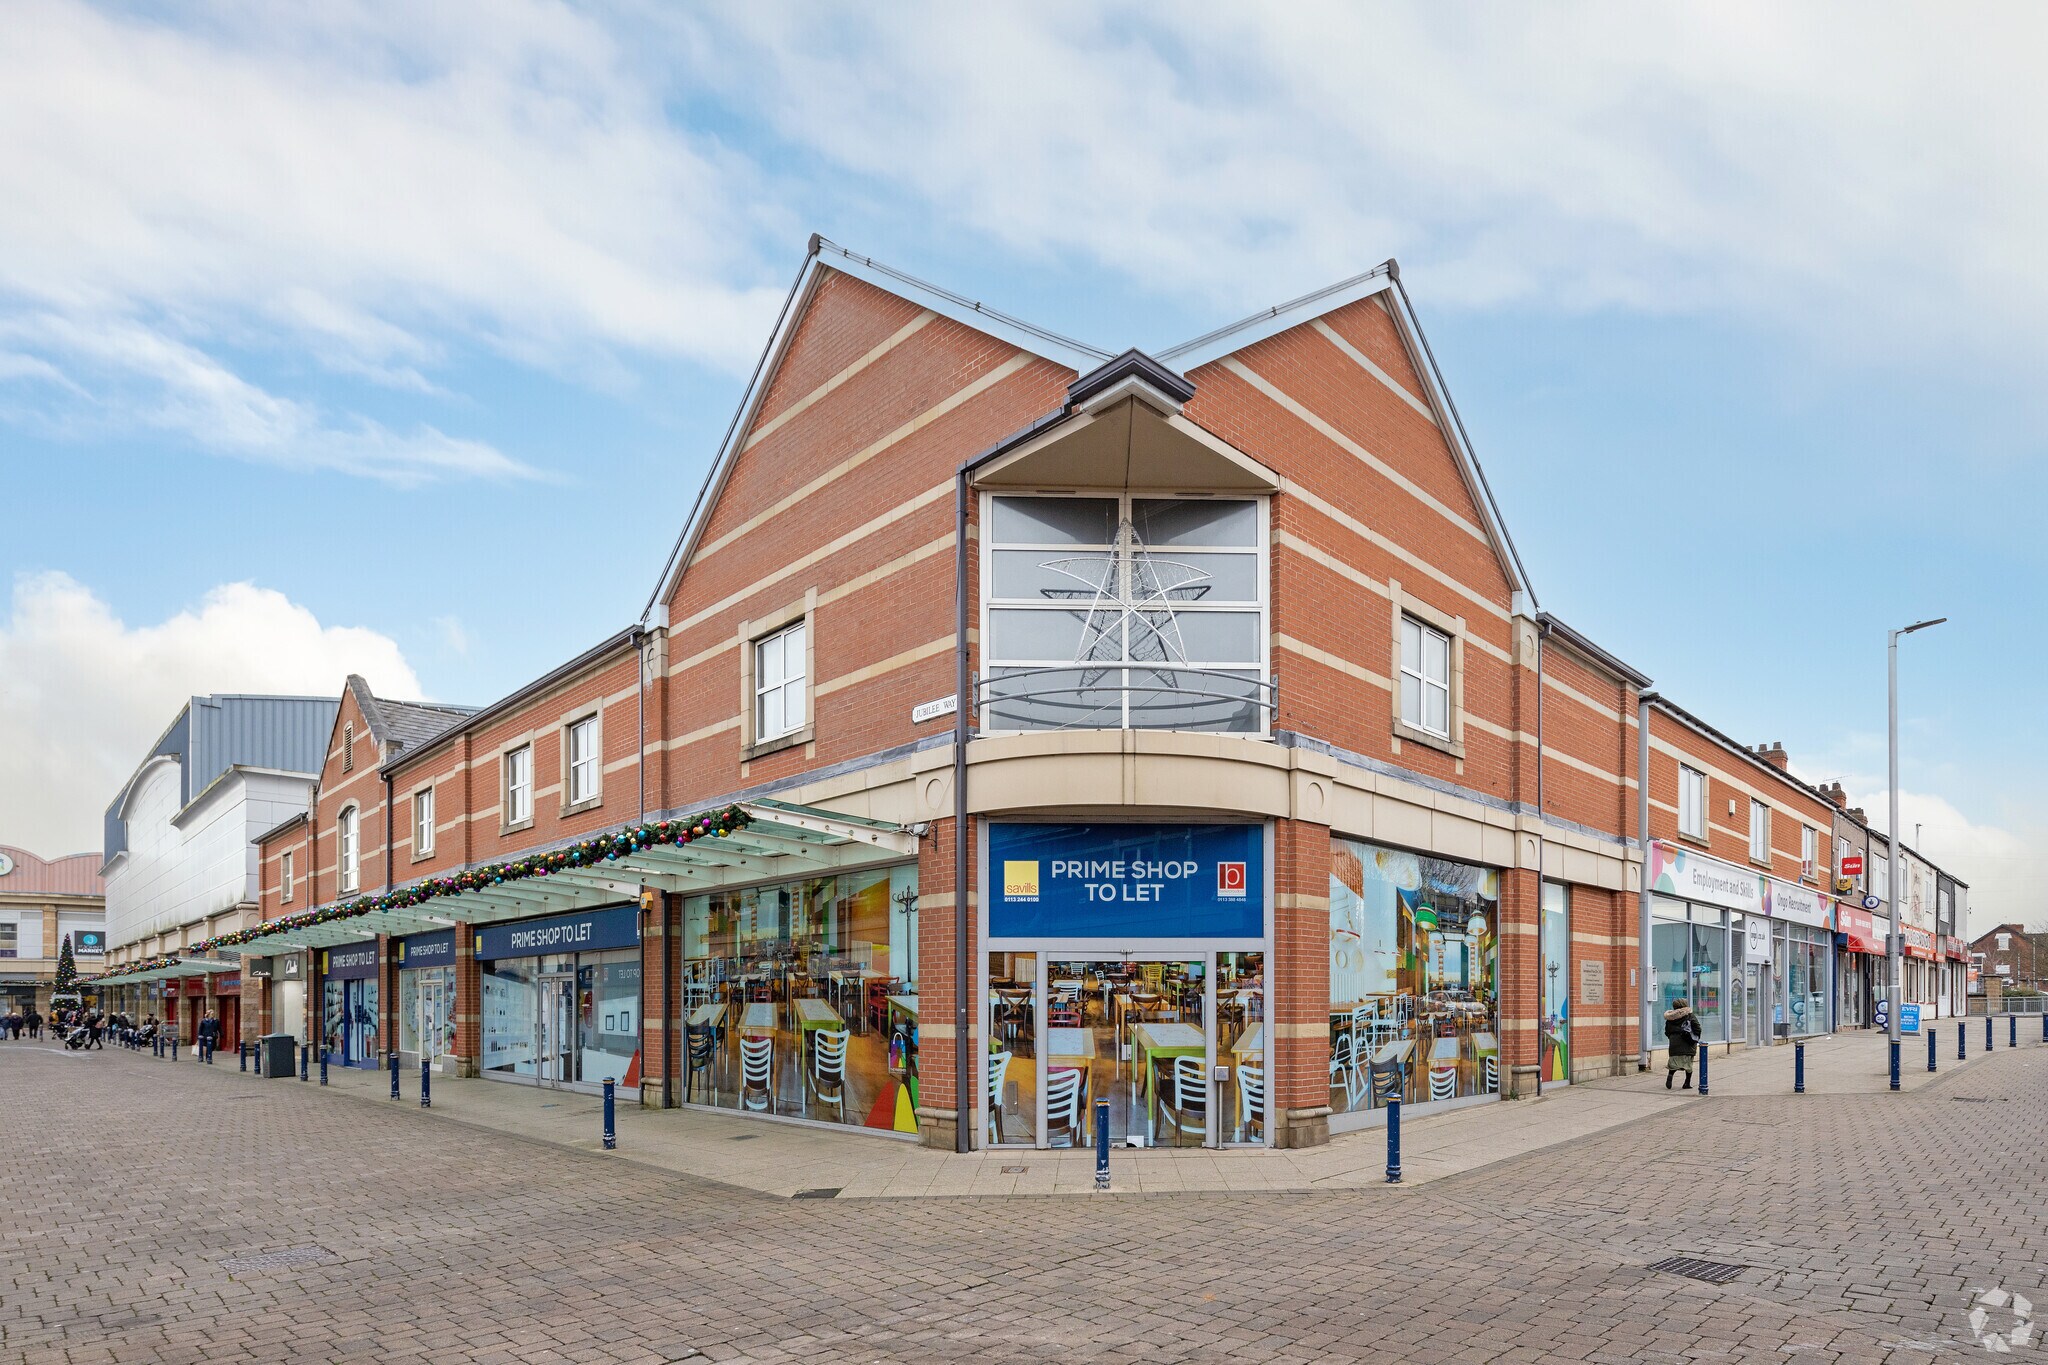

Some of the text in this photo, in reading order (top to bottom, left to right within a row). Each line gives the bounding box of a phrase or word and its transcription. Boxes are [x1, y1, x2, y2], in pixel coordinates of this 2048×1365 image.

[916, 699, 956, 718] JUBILEE WAY
[1051, 860, 1199, 879] PRIME SHOP
[1006, 882, 1037, 894] savills
[1084, 883, 1165, 902] TO LET
[1693, 868, 1754, 899] Employment and Skills
[1777, 893, 1811, 914] Ongo Recruitment
[512, 922, 592, 949] PRIME SHOP TO LET
[411, 942, 449, 957] PRIME SHOP TO LET
[333, 951, 375, 968] PRIME SHOP TO LET
